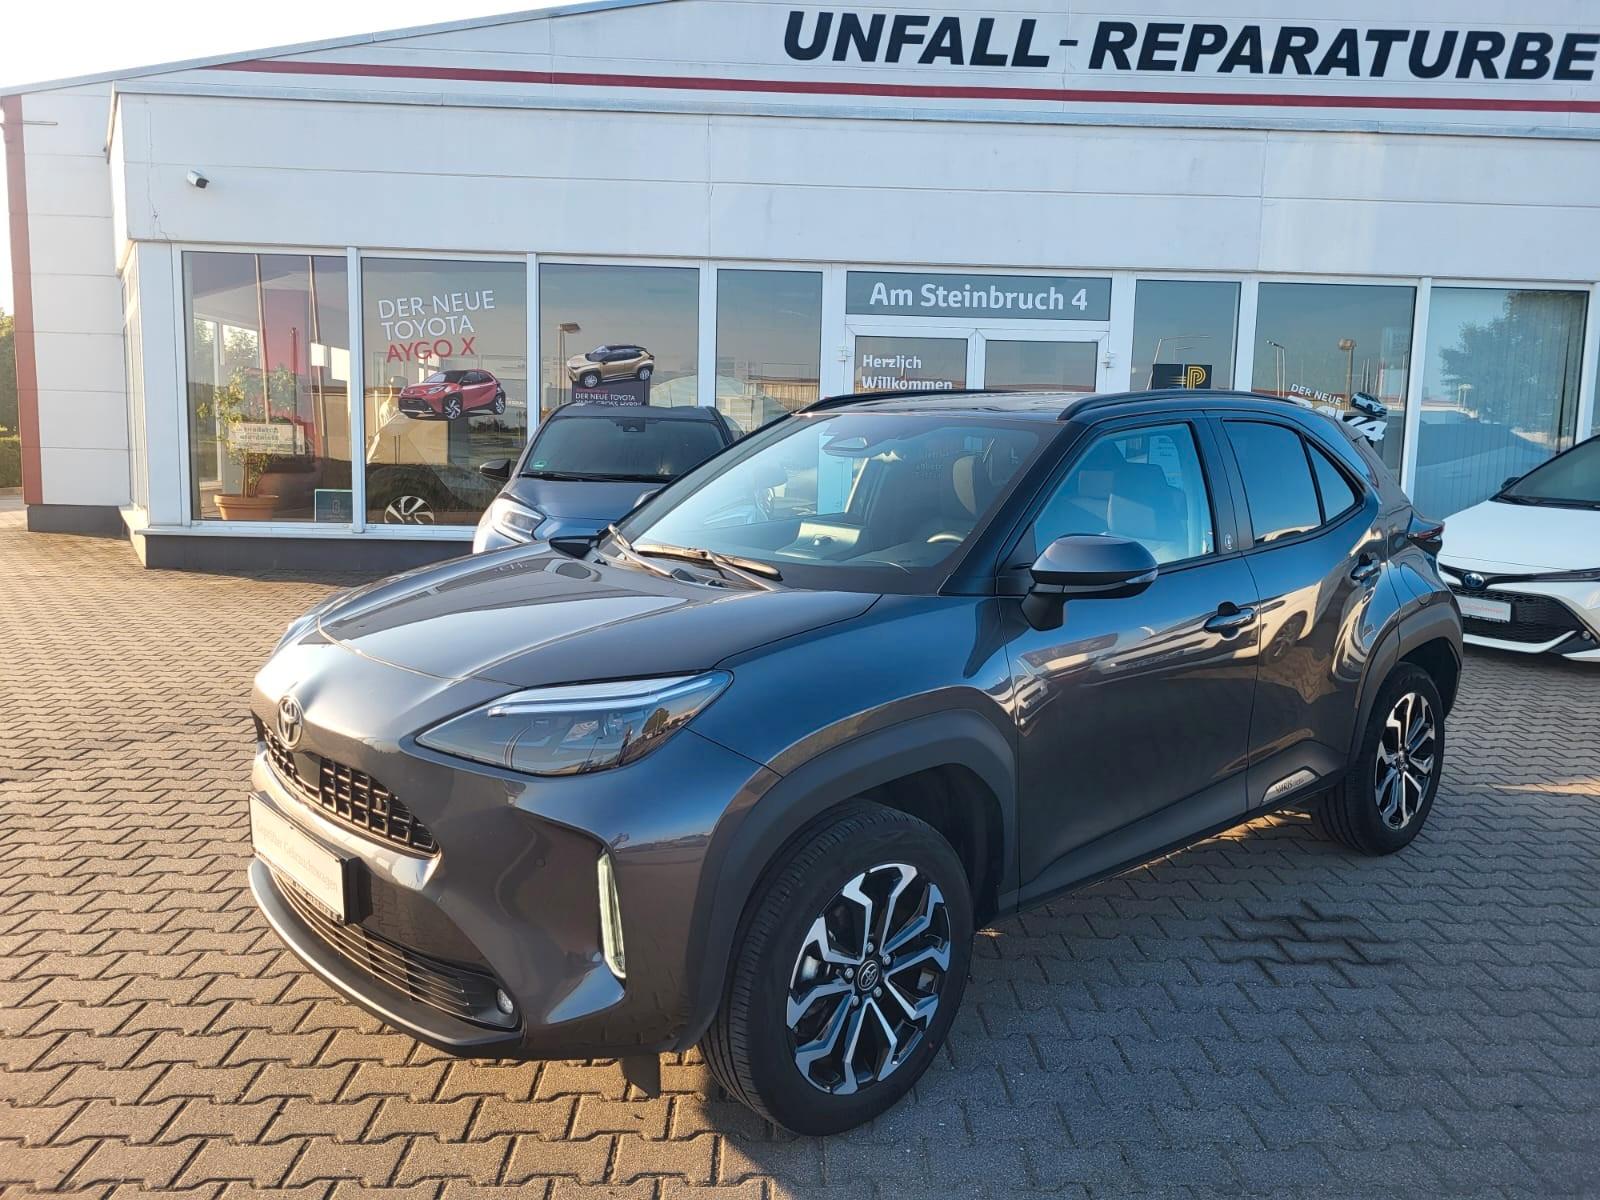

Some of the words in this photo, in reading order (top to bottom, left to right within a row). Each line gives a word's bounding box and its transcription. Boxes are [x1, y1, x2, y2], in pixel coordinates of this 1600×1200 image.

[378, 296, 425, 319] DER
[432, 290, 496, 314] NEUE
[870, 282, 913, 306] Am
[920, 283, 1064, 310] Steinbruch
[1071, 288, 1088, 311] 4
[381, 315, 475, 341] TOYOTA
[387, 340, 452, 362] AYGO
[462, 337, 476, 355] X
[863, 354, 922, 369] Herzlich
[862, 375, 953, 390] Willkommen
[1290, 383, 1312, 397] DER
[1313, 389, 1343, 406] NEUE
[575, 392, 588, 400] DER
